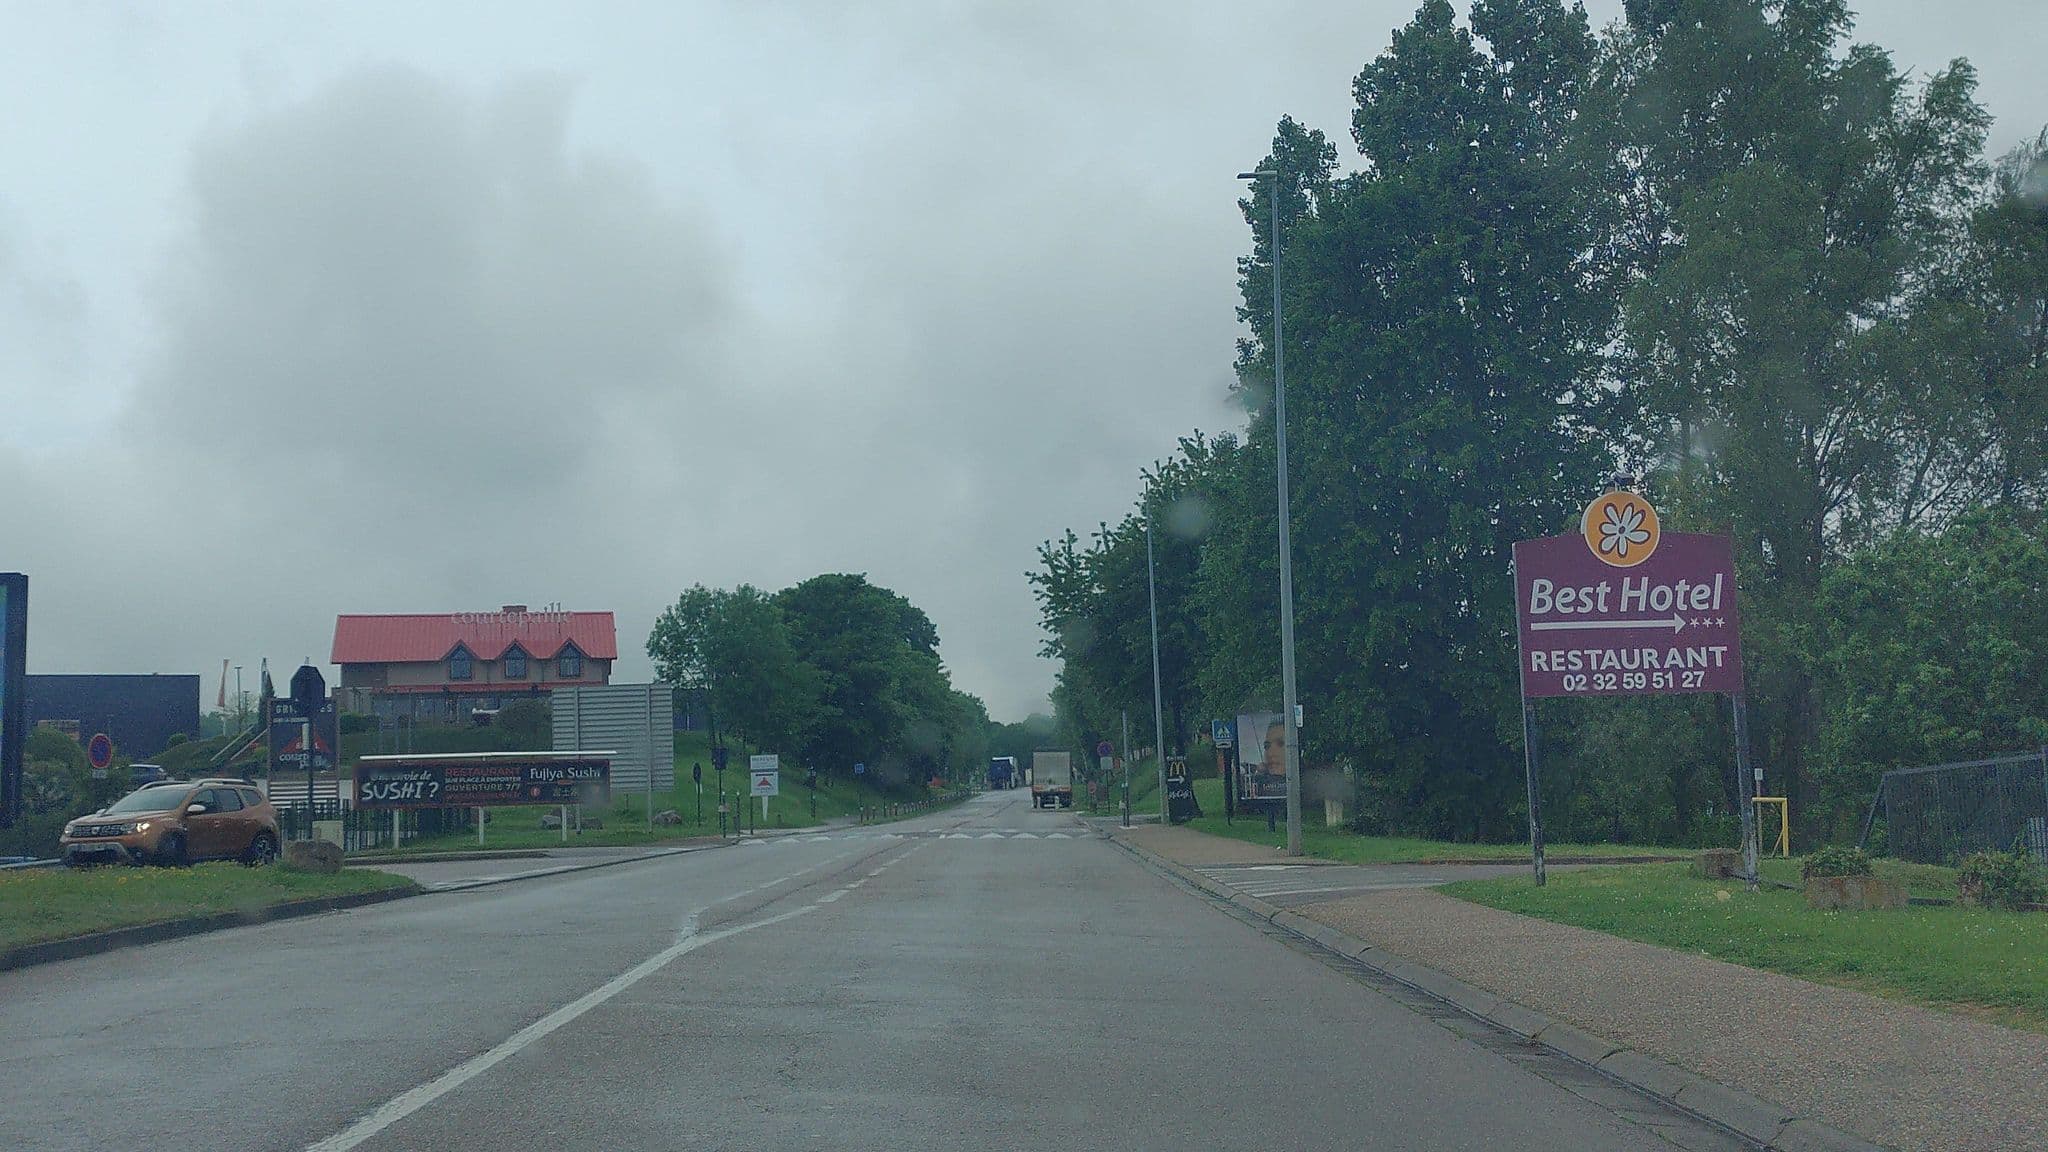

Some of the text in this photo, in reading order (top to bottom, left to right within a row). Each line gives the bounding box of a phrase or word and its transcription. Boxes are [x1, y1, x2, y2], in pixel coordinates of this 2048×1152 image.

[1529, 573, 1723, 615] Best Hotel
[1530, 646, 1727, 672] RESTAURANT
[1563, 670, 1705, 692] 02 32 59 51 27
[567, 767, 601, 778] Sushi
[361, 781, 424, 800] SUSHI
[428, 781, 439, 798] ?
[444, 783, 503, 791] OUVERTURE
